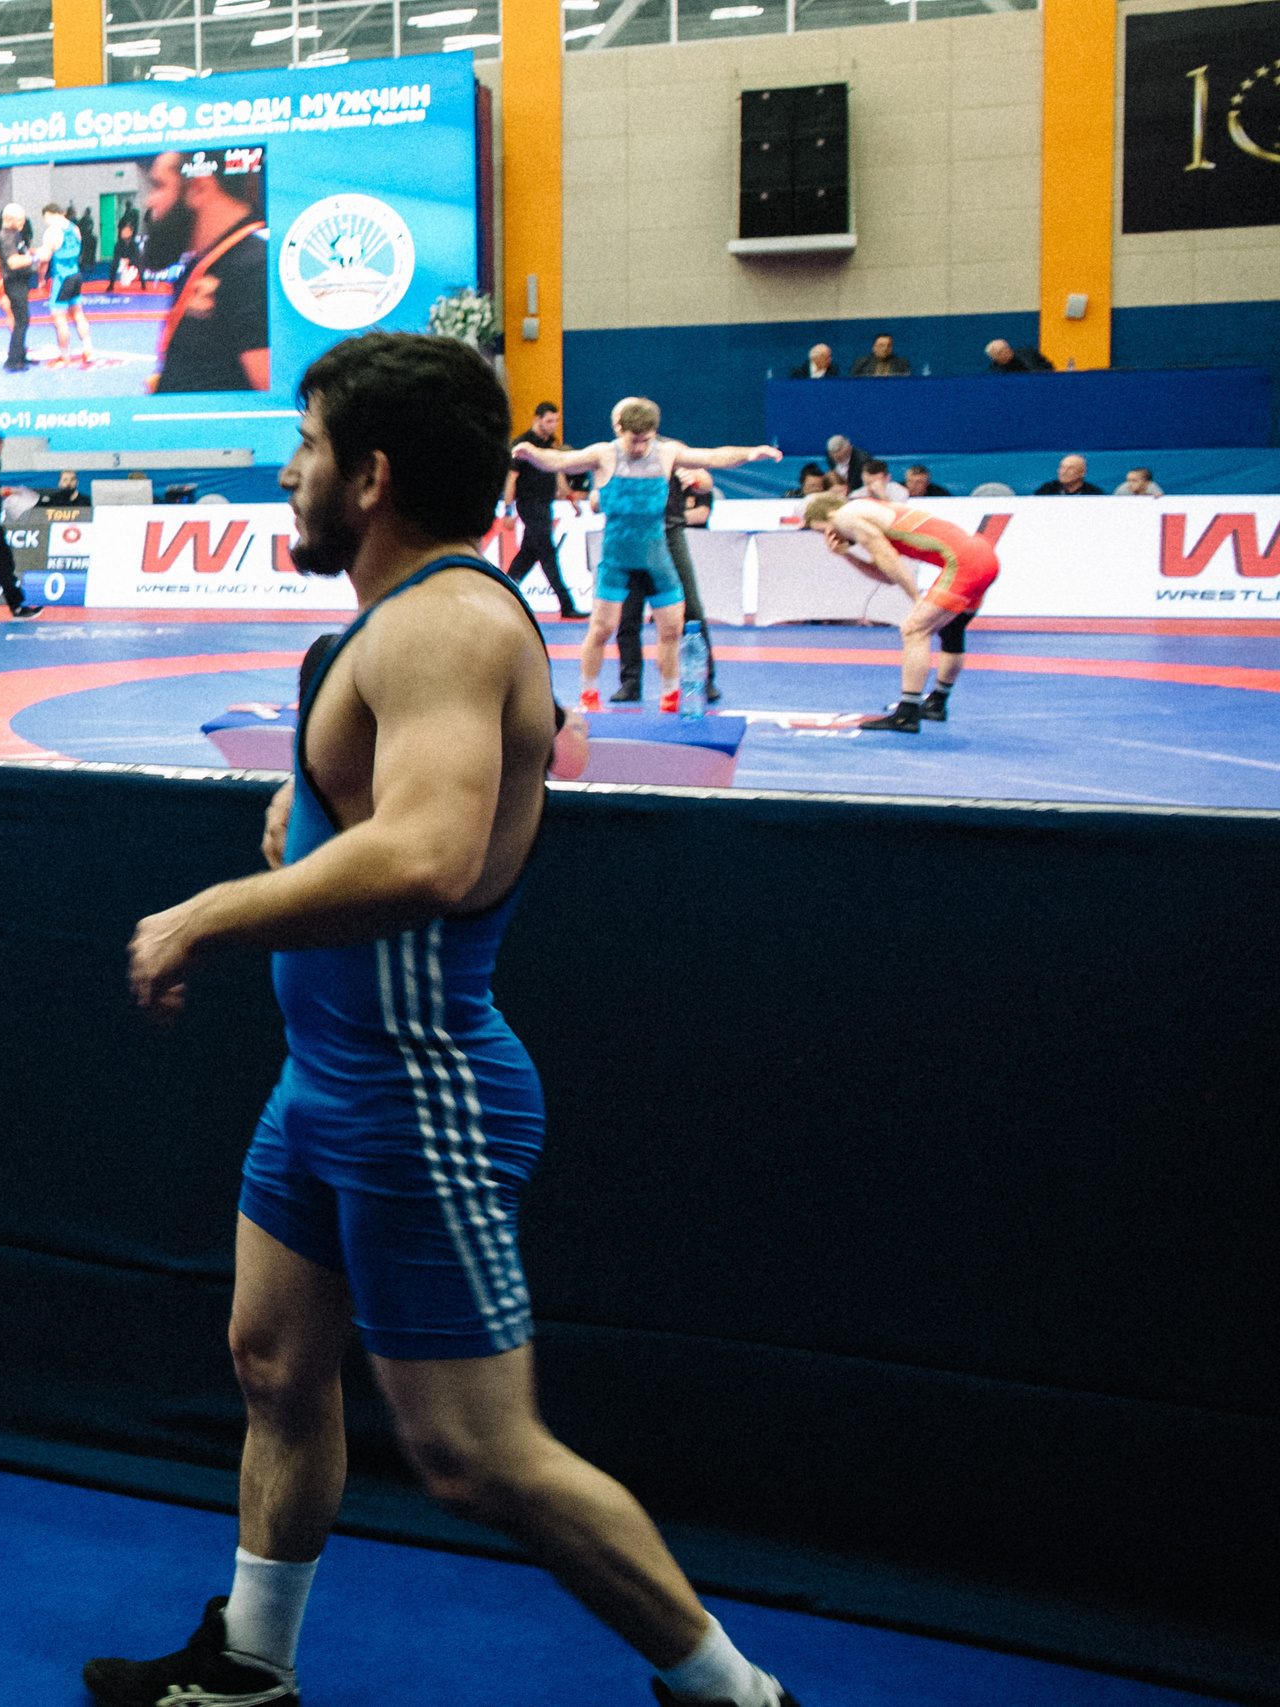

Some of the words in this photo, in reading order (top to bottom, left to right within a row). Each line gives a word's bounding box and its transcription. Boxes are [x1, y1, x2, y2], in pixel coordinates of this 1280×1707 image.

[74, 101, 188, 137] борьбе
[195, 96, 291, 127] среди
[300, 83, 431, 118] мужчин
[34, 409, 111, 430] декабря
[44, 572, 66, 601] 0
